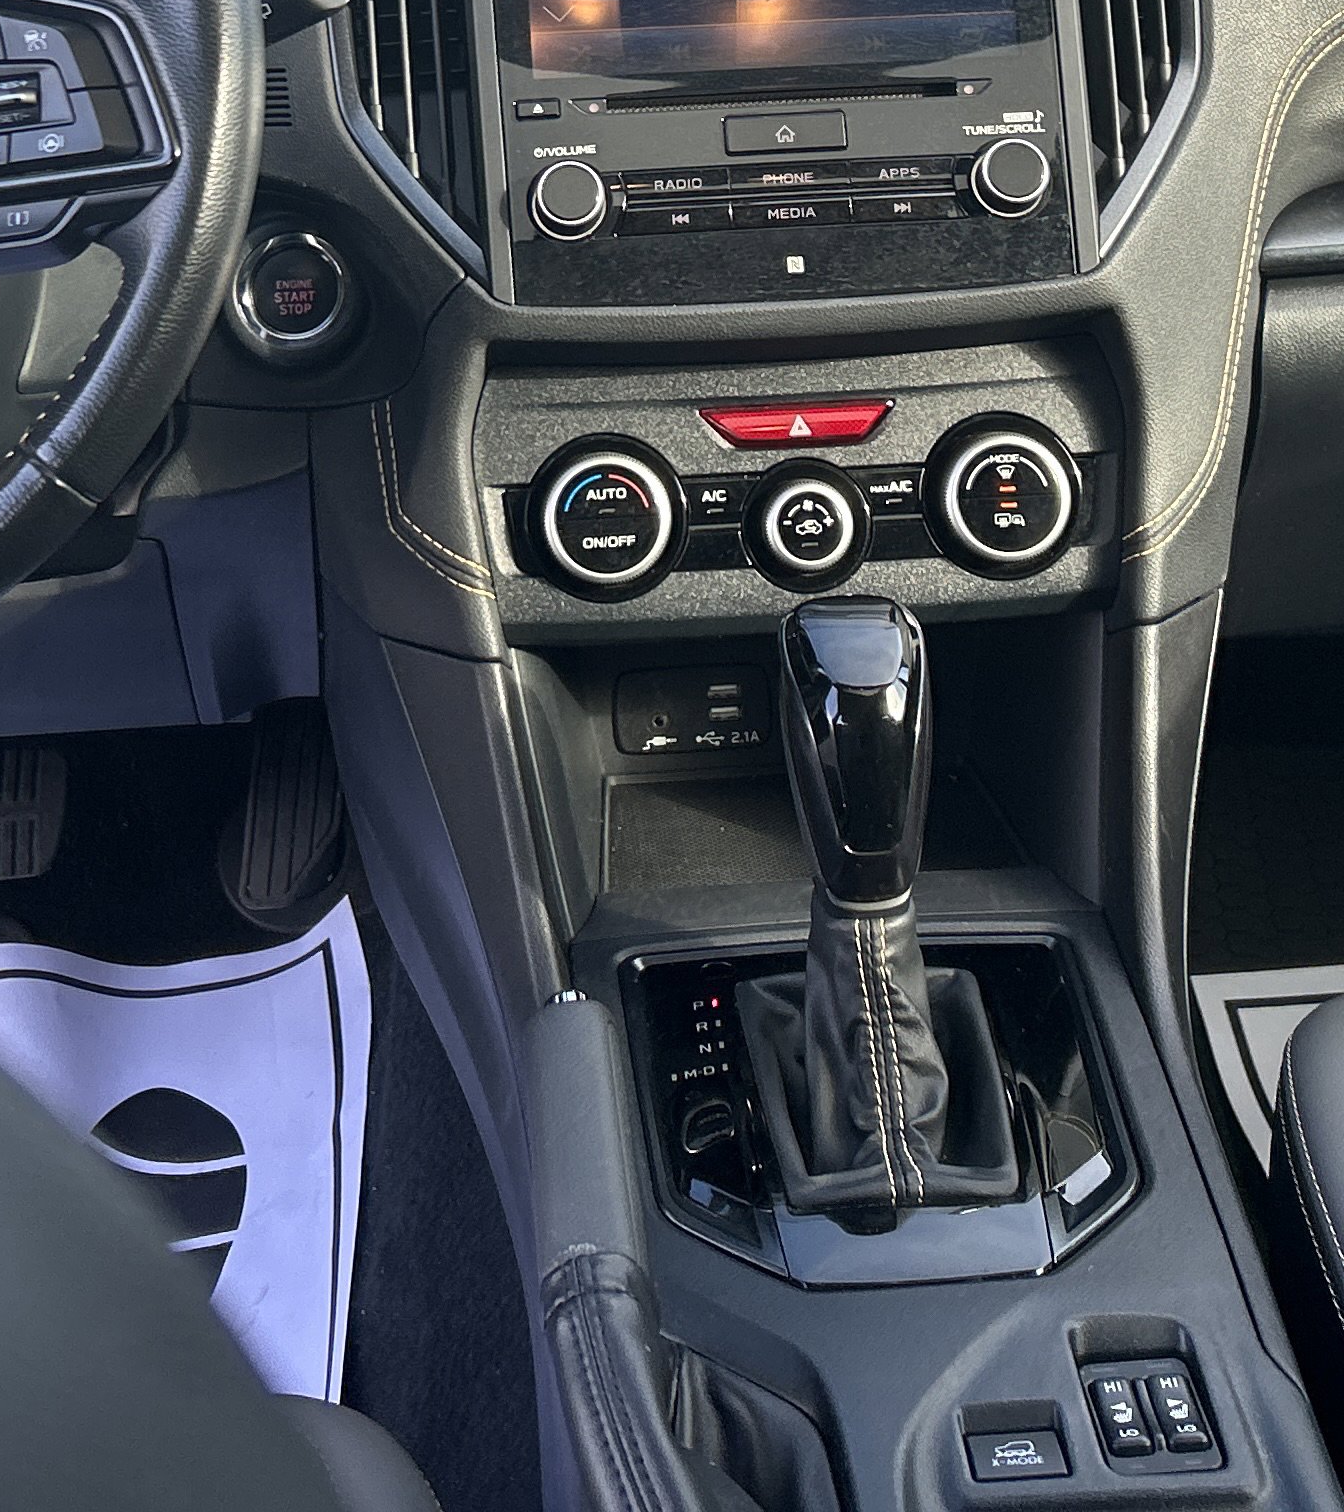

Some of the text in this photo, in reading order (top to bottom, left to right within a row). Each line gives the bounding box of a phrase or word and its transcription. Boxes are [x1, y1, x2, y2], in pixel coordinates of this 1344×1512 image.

[962, 123, 1046, 136] TUNE/SCROLL
[762, 171, 814, 185] PHONE
[878, 167, 921, 180] APPS
[654, 177, 703, 190] RADIO
[767, 206, 817, 220] MEDIA
[276, 278, 314, 289] ENGINE
[274, 290, 316, 303] START
[279, 303, 312, 316] STOP
[989, 453, 1020, 464] MODE
[586, 487, 627, 500] AUTO
[701, 489, 727, 502] A/C
[582, 534, 636, 549] ON/OFF
[731, 730, 760, 743] 2.1A
[693, 1000, 704, 1011] P
[696, 1021, 708, 1032] R
[699, 1043, 712, 1054] N
[1103, 1380, 1123, 1393] HI
[1160, 1376, 1179, 1389] HI
[1119, 1427, 1140, 1438] LO
[1176, 1423, 1197, 1434] LO
[991, 1455, 1044, 1467] X-MODE
